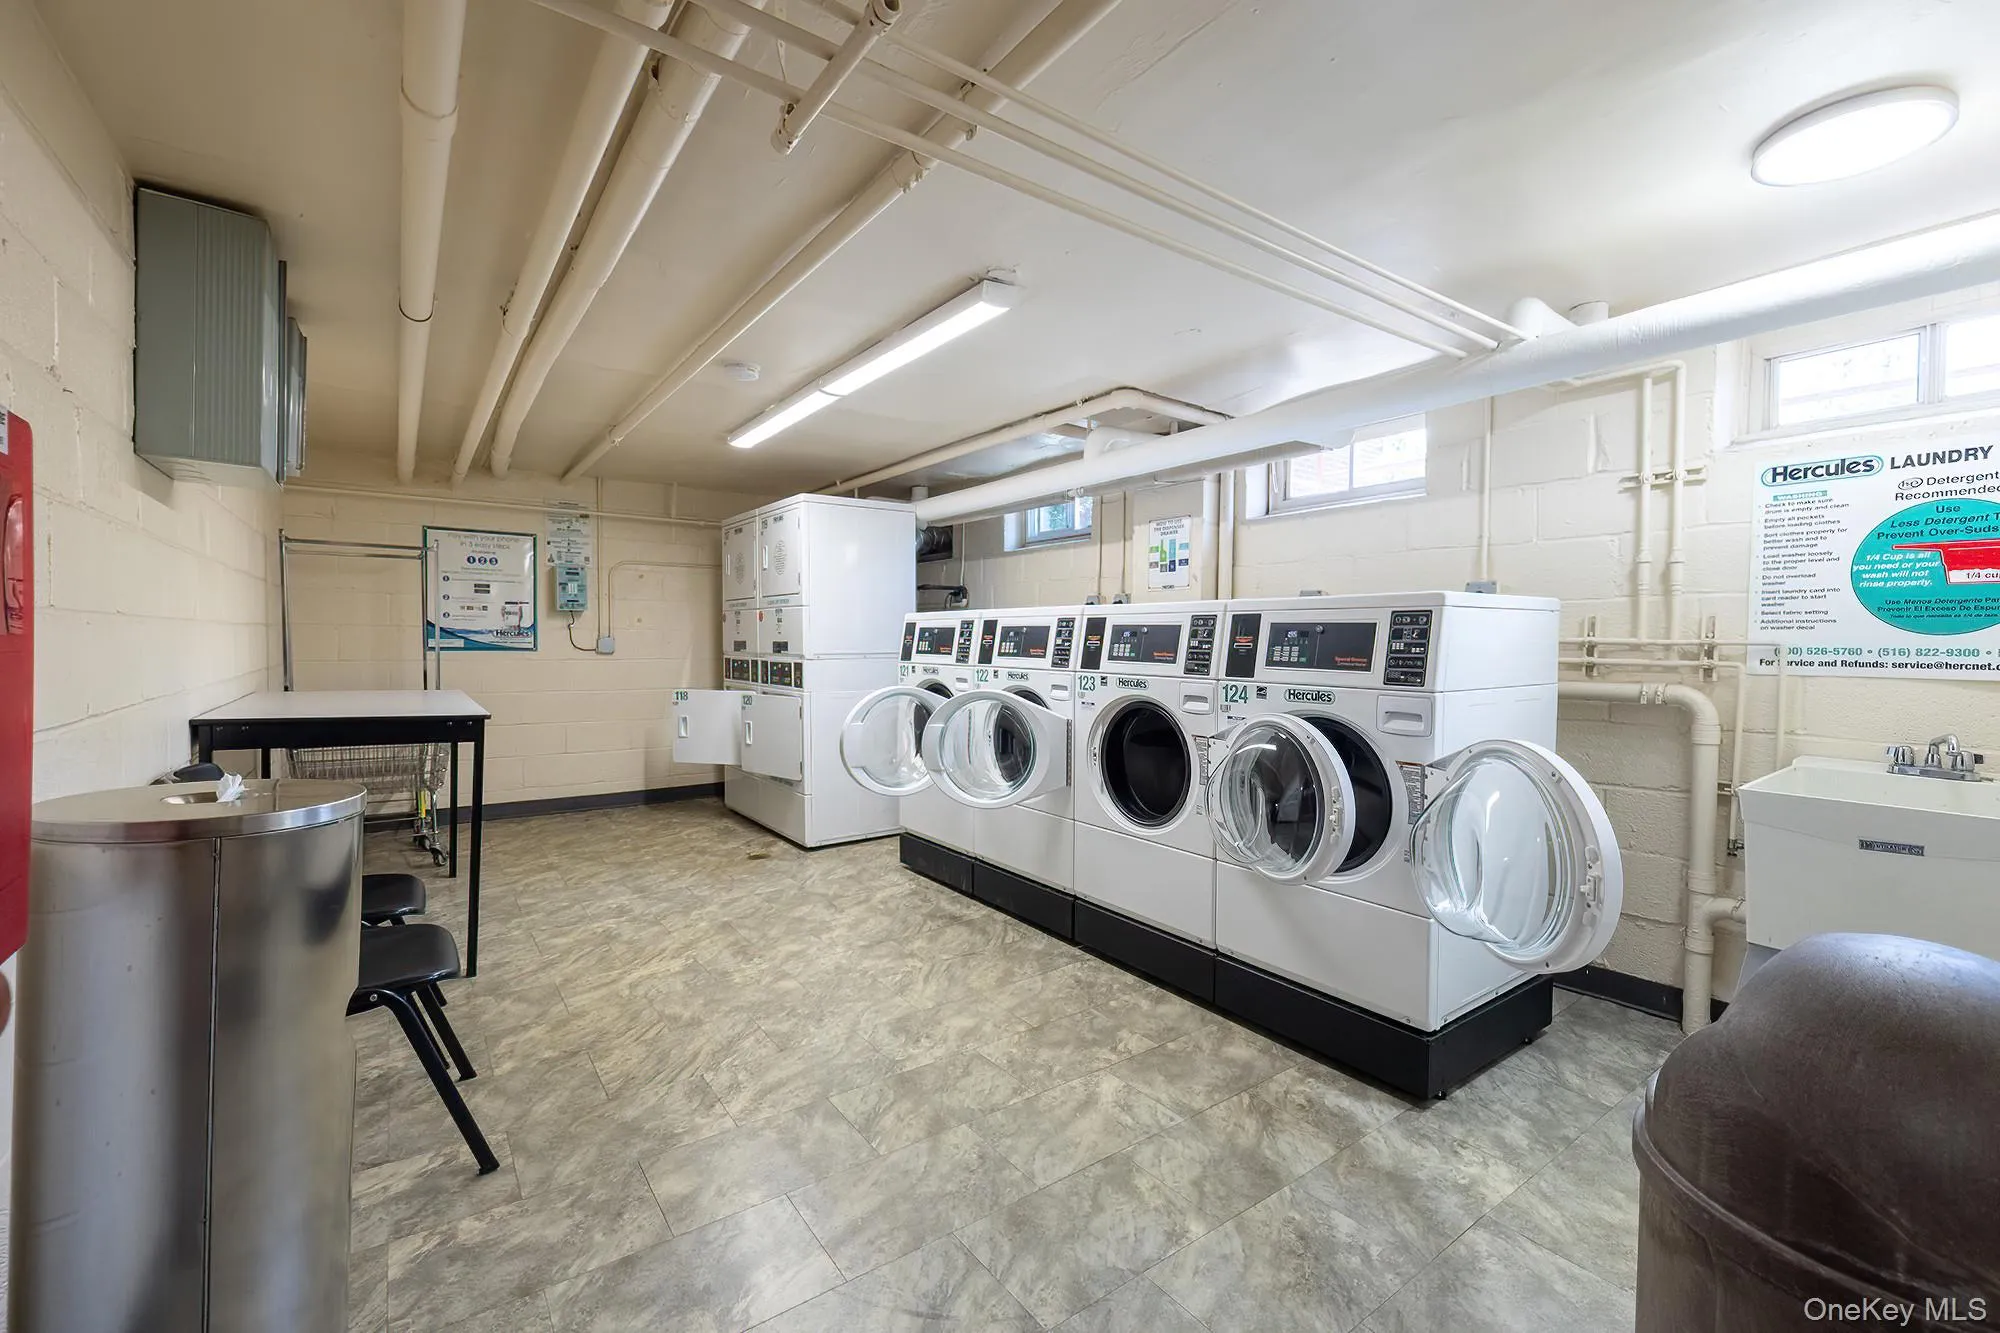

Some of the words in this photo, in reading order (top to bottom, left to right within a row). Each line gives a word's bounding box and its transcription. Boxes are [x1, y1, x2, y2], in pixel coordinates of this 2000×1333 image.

[1890, 444, 1994, 470] LAUNDRY
[1771, 458, 1875, 484] Hercules
[1926, 470, 2000, 486] Detergent
[1935, 505, 1961, 513] Use
[1890, 519, 1921, 528] Less
[1924, 512, 1990, 525] Detergent
[1805, 528, 1836, 536] properly
[1876, 529, 1925, 540] Prevent
[1866, 553, 1880, 561] 1/4
[1882, 553, 1904, 562] Cup
[1917, 551, 1932, 559] all
[1853, 564, 1872, 572] you
[1873, 562, 1900, 570] need
[1915, 561, 1941, 569] your
[1862, 571, 1889, 579] wash
[1891, 570, 1909, 578] will
[1859, 580, 1885, 588] rinse
[1886, 579, 1933, 588] properly.
[1806, 647, 1863, 656] 526-5760
[1878, 647, 1911, 658] (516)
[1915, 648, 1980, 657] 822-9300
[1759, 658, 1776, 666] For
[1817, 659, 1838, 667] and
[1840, 659, 1889, 669] Refunds:
[899, 665, 909, 677] 121
[976, 669, 989, 682] 122
[1007, 671, 1029, 680] Hercules
[1078, 675, 1096, 691] 123
[1117, 677, 1147, 688] Hercules
[675, 691, 689, 701] 118
[1222, 684, 1248, 703] 124
[1287, 688, 1334, 703] Hercules
